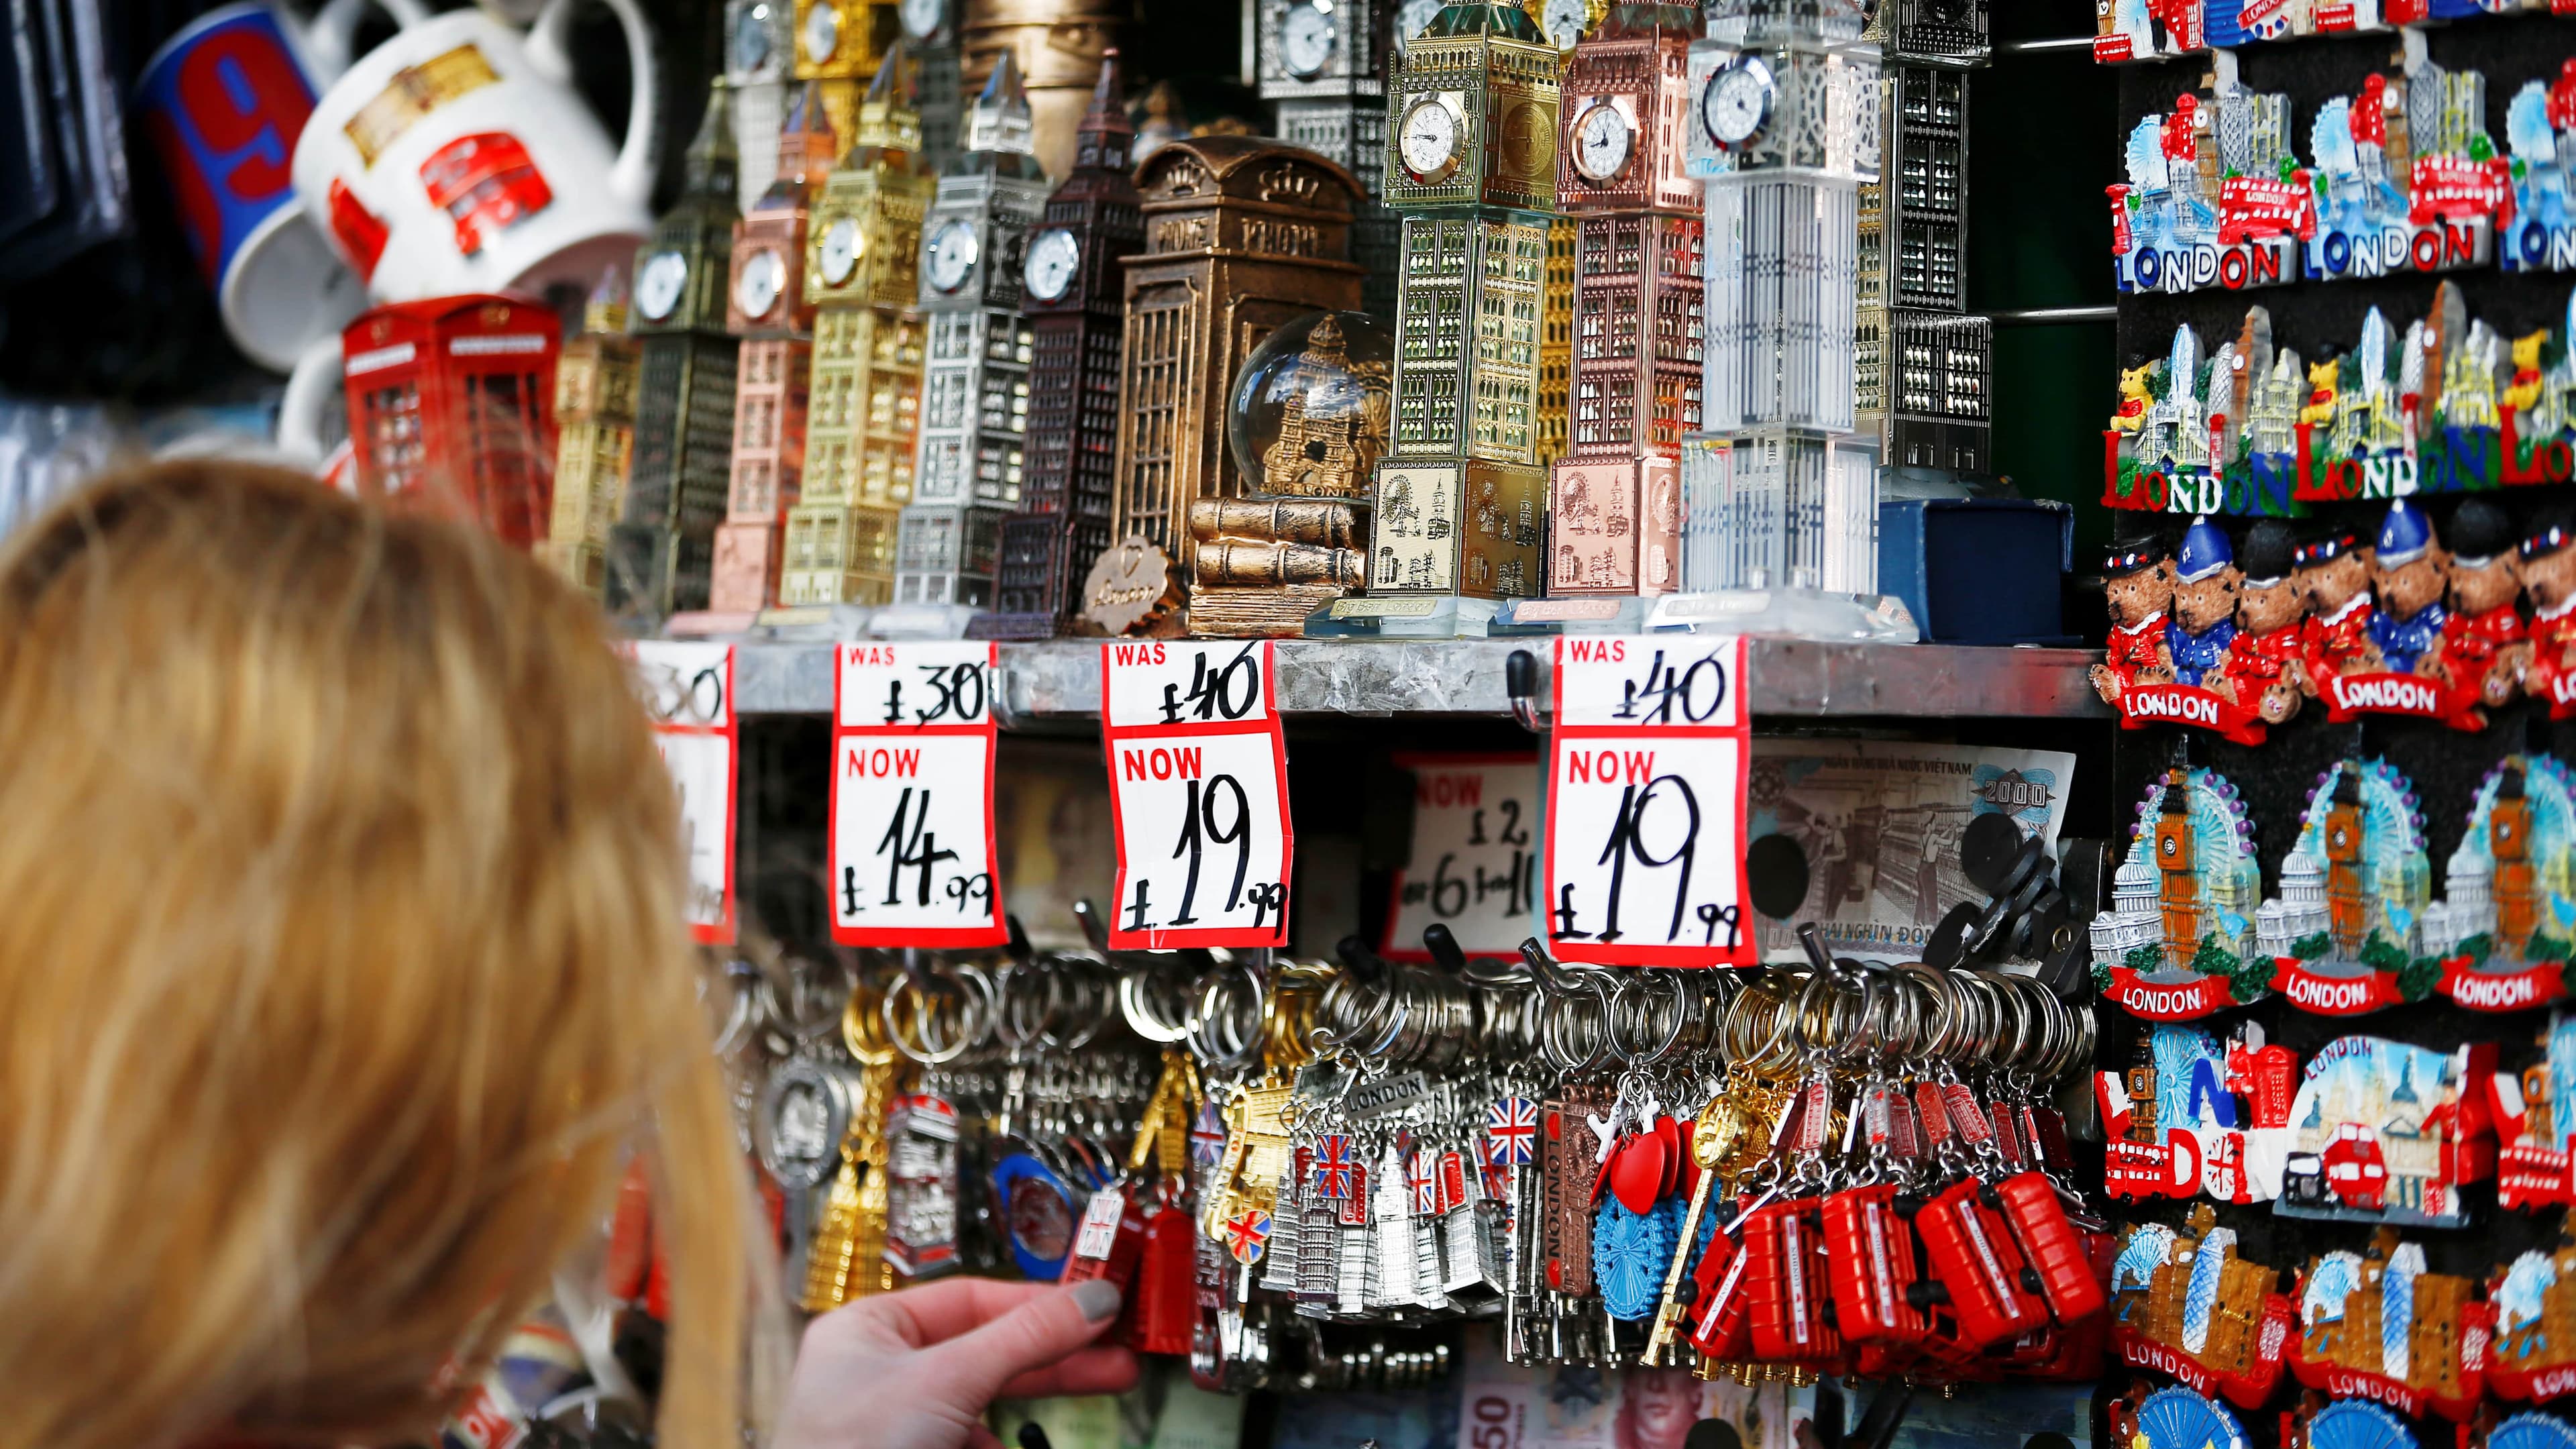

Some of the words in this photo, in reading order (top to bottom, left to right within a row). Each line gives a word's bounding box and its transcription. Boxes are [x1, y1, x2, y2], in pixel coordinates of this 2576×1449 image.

[2246, 0, 2280, 21] LOND
[2303, 225, 2474, 280] LONDON
[2500, 222, 2576, 272] LON
[2115, 243, 2281, 294] LONDON
[2101, 431, 2297, 517] LONDON
[2294, 423, 2492, 501] LONDON
[849, 647, 895, 667] WAS
[1116, 643, 1166, 667] WAS
[1570, 639, 1625, 663] WAS
[883, 661, 985, 726] £30
[1159, 642, 1259, 724] £40
[1612, 642, 1729, 726] £40
[2332, 676, 2436, 713] LONDON
[2125, 692, 2218, 724] LONDON
[848, 749, 920, 778] NOW
[1124, 747, 1201, 782] NOW
[1570, 751, 1655, 785] NOW
[1948, 761, 1972, 775] NAM
[1985, 780, 2047, 808] 2000
[842, 788, 994, 918] £14.99
[1122, 774, 1288, 939] £19.99
[1550, 775, 1741, 955] £19.99
[2123, 987, 2202, 1013] LONDON
[2286, 975, 2367, 1009] LONDON
[2453, 975, 2533, 1006] LONDON
[2304, 1036, 2373, 1080] LONDON
[1346, 1077, 1421, 1112] LONDON
[1548, 1141, 1560, 1259] LONDON
[1790, 1246, 1803, 1287] LONDON
[2125, 1341, 2205, 1390] LONDON
[2532, 1368, 2576, 1397] LON
[2328, 1373, 2412, 1413] LONDON
